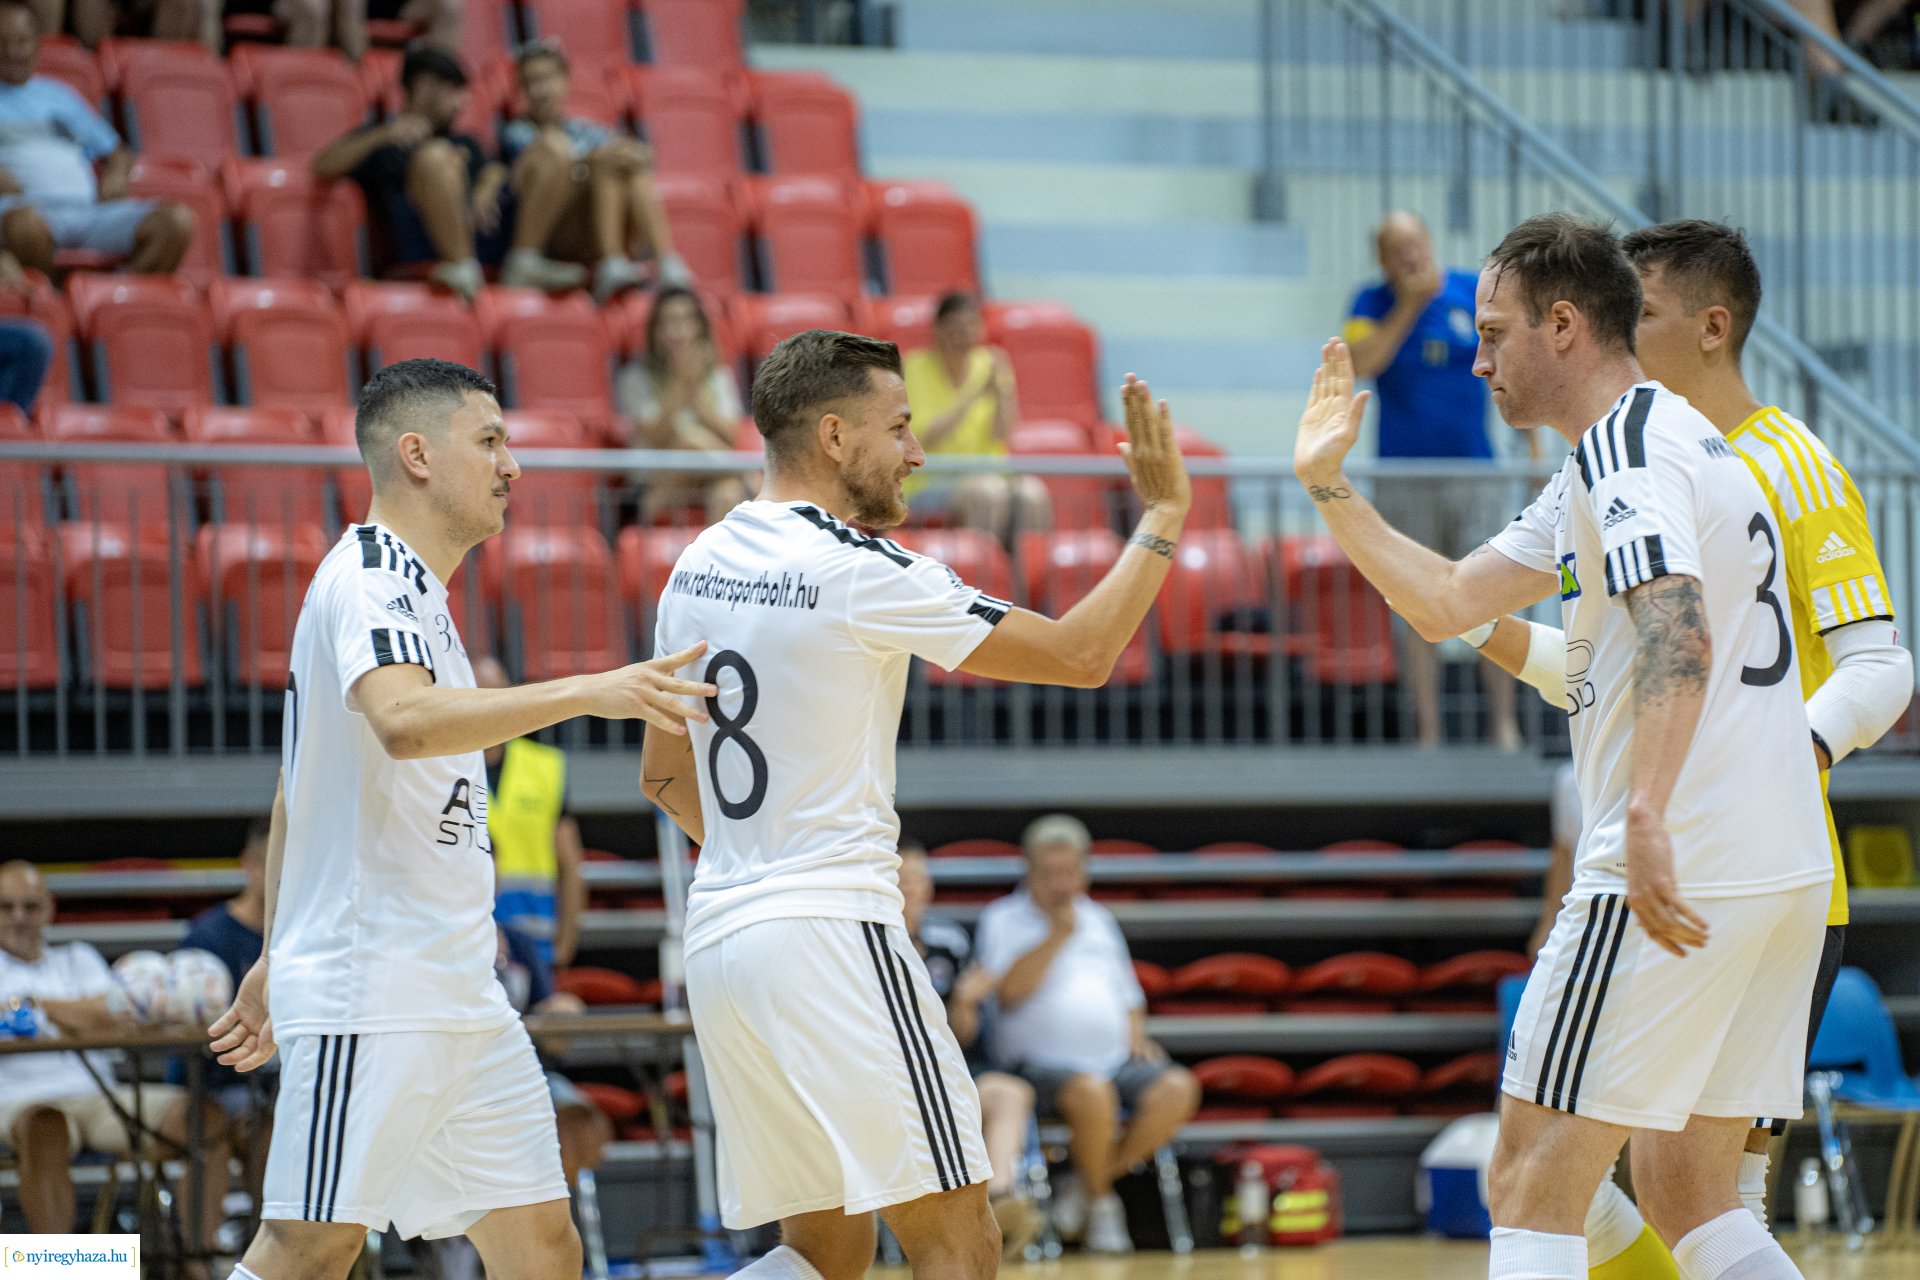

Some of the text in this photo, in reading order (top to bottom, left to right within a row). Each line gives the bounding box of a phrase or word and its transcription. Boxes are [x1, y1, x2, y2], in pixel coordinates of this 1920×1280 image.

[672, 564, 819, 611] www.raktarsportbolt.hu
[1741, 512, 1793, 687] 3
[1815, 547, 1856, 563] adidas
[705, 650, 768, 820] 8
